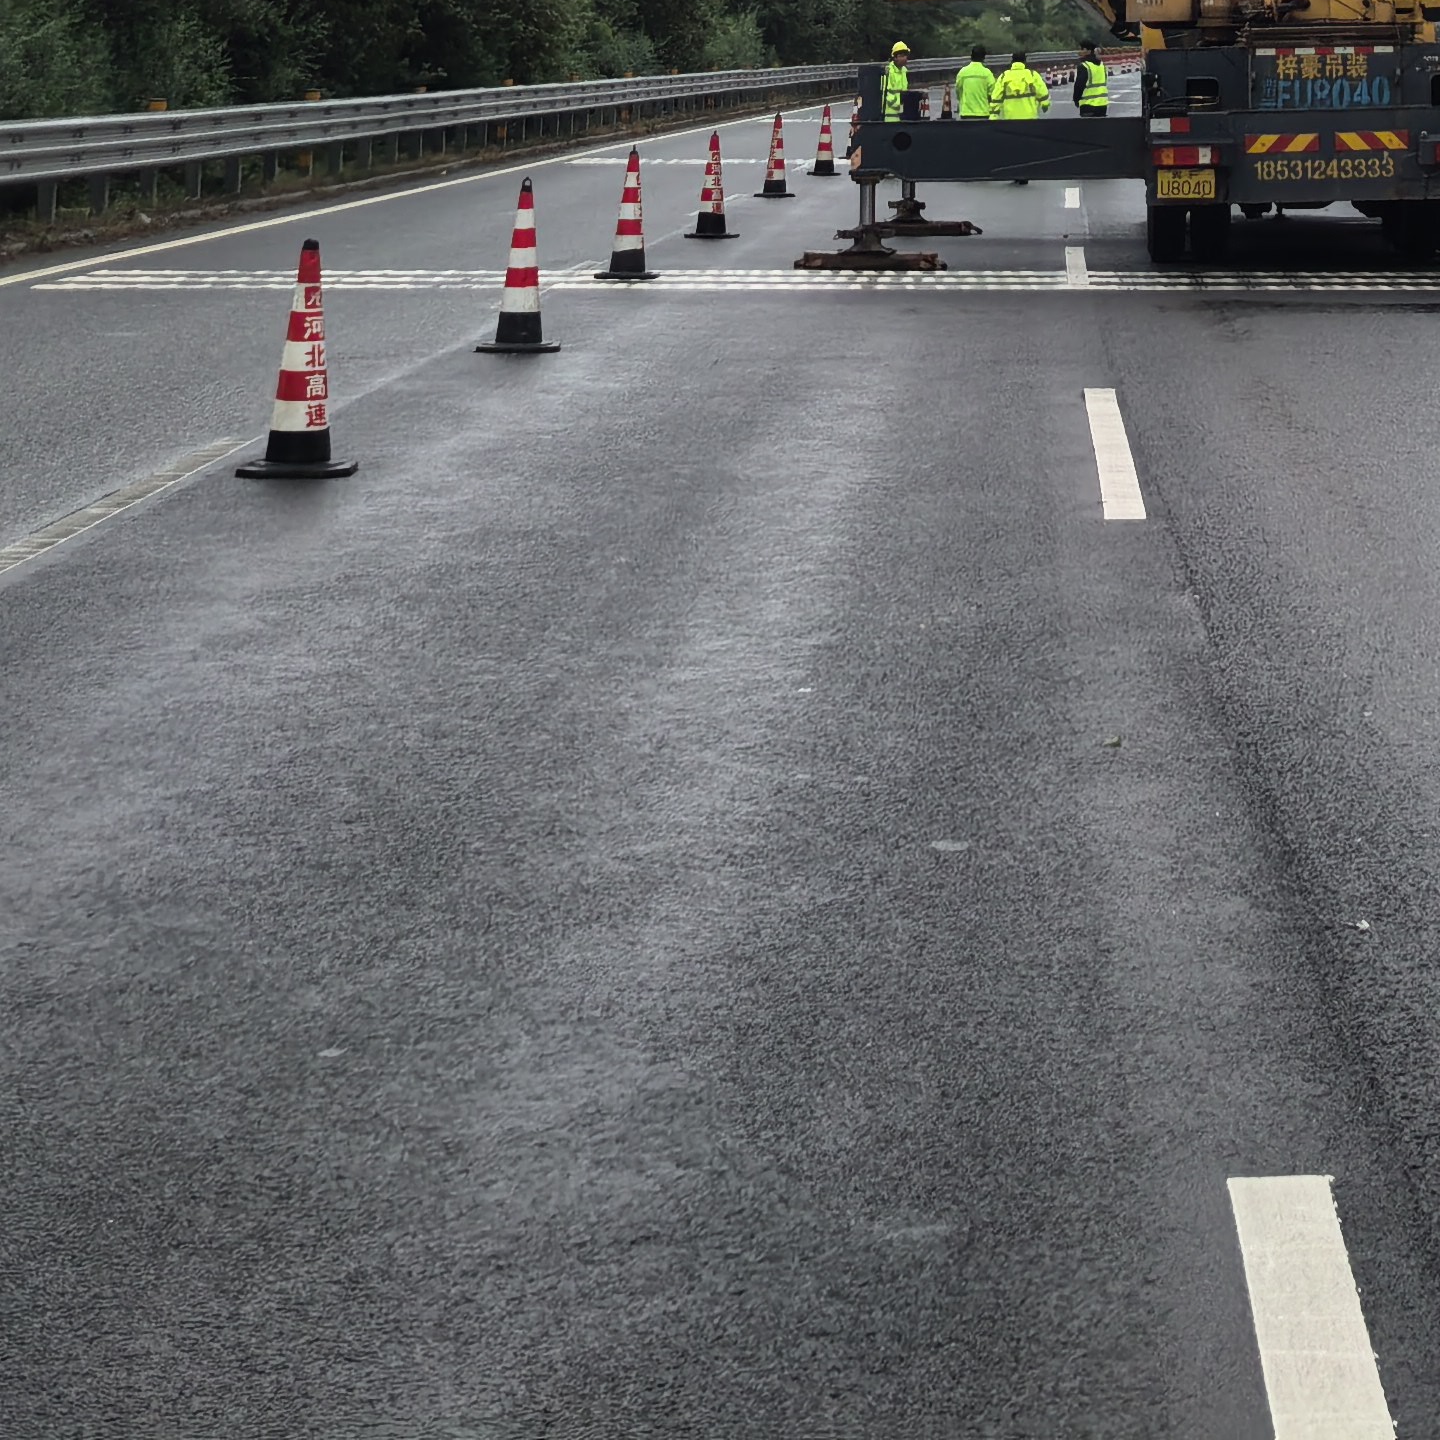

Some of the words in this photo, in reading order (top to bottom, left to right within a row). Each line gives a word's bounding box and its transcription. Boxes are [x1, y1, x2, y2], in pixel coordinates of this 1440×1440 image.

[1254, 158, 1395, 181] 18531243333
[304, 315, 327, 428] 河北高速
